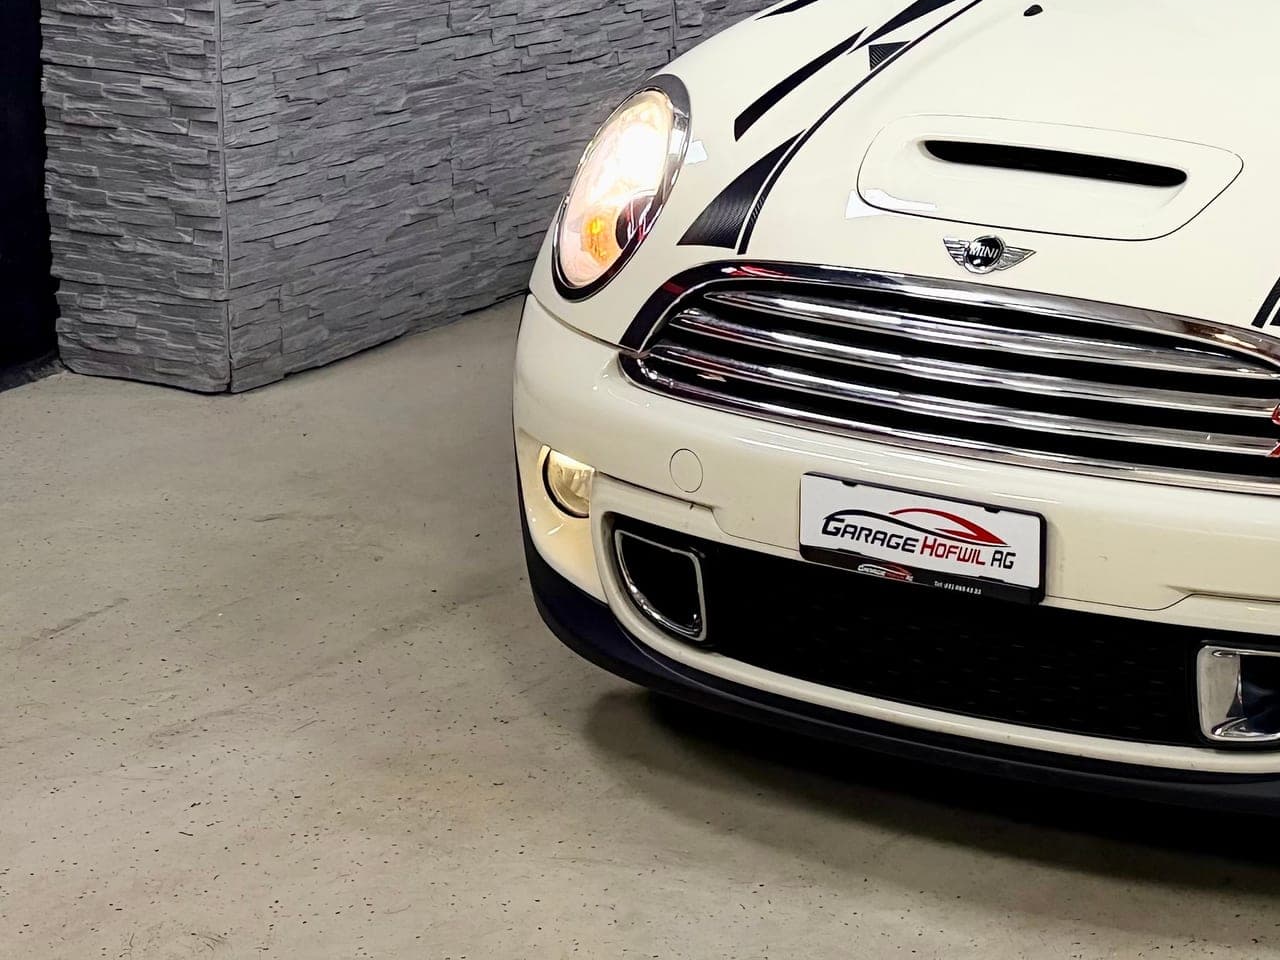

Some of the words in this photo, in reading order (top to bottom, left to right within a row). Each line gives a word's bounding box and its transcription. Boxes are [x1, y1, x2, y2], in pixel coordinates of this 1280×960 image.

[968, 243, 999, 259] MINI
[821, 516, 919, 554] GARAGE
[920, 535, 986, 566] HOFWIL
[990, 550, 1017, 570] AG
